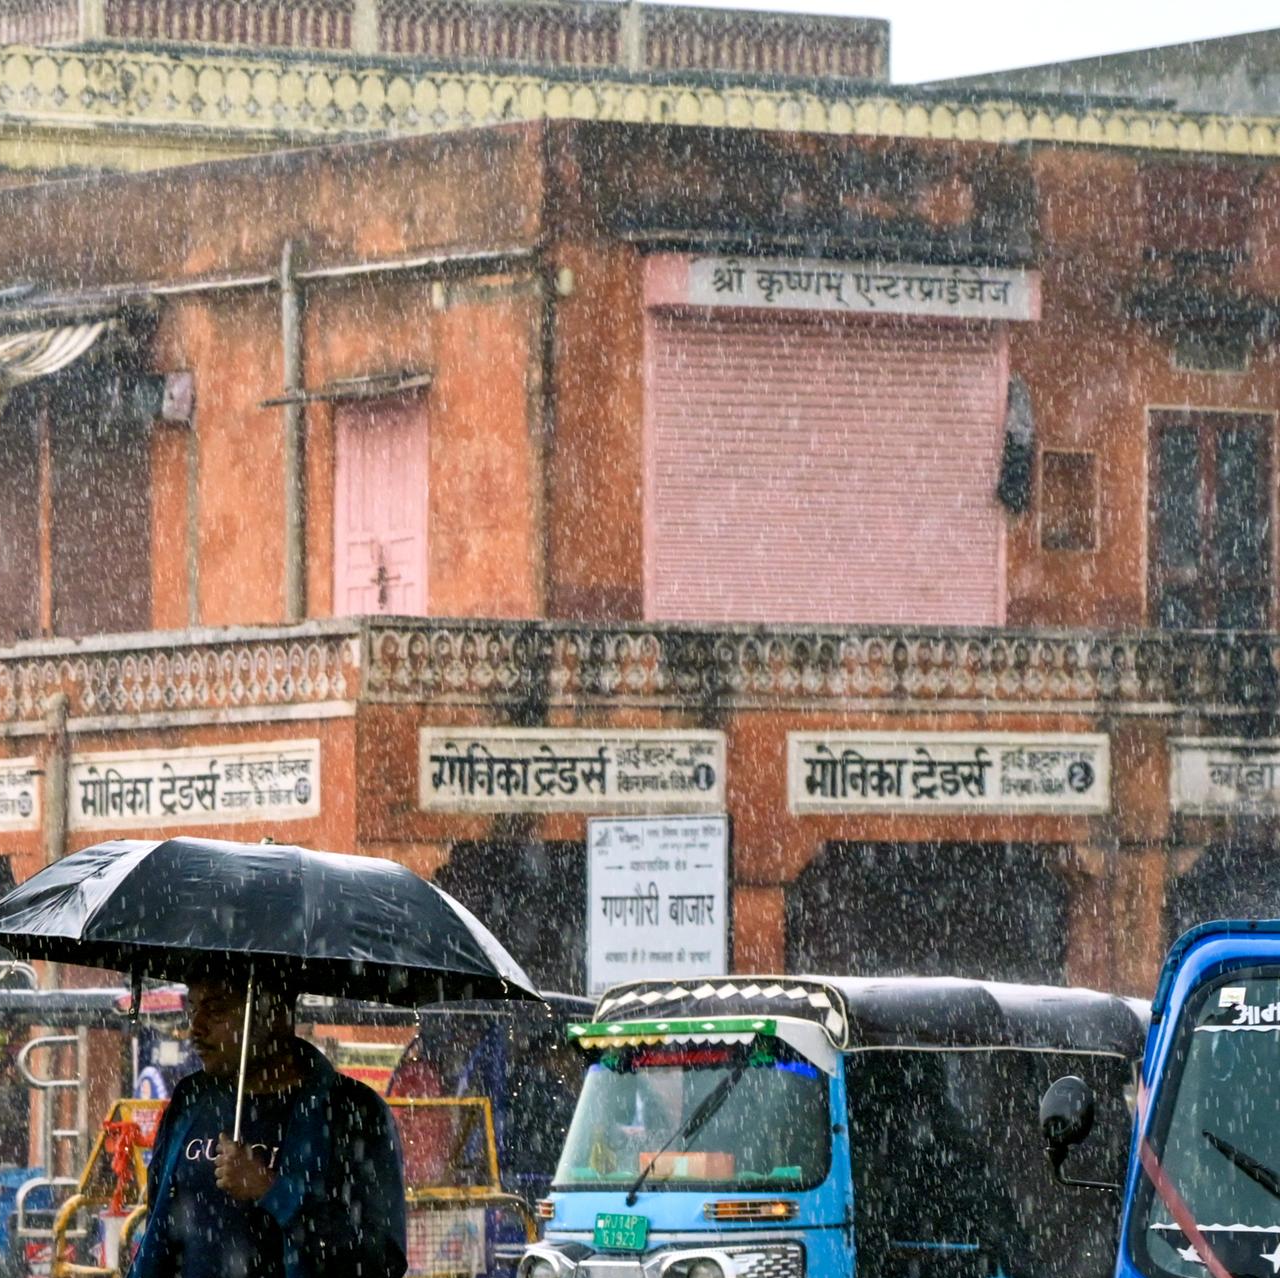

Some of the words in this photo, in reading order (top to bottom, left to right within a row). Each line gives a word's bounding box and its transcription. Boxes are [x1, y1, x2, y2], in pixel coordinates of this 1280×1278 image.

[712, 264, 745, 293] श्री
[79, 765, 153, 817] मोनिका
[158, 760, 220, 816] ट्रेडर्स
[533, 744, 611, 797] ट्रेडर्स
[804, 744, 908, 799] मोनिका
[912, 746, 994, 799] ट्रेडर्स
[668, 894, 714, 926] बाजार
